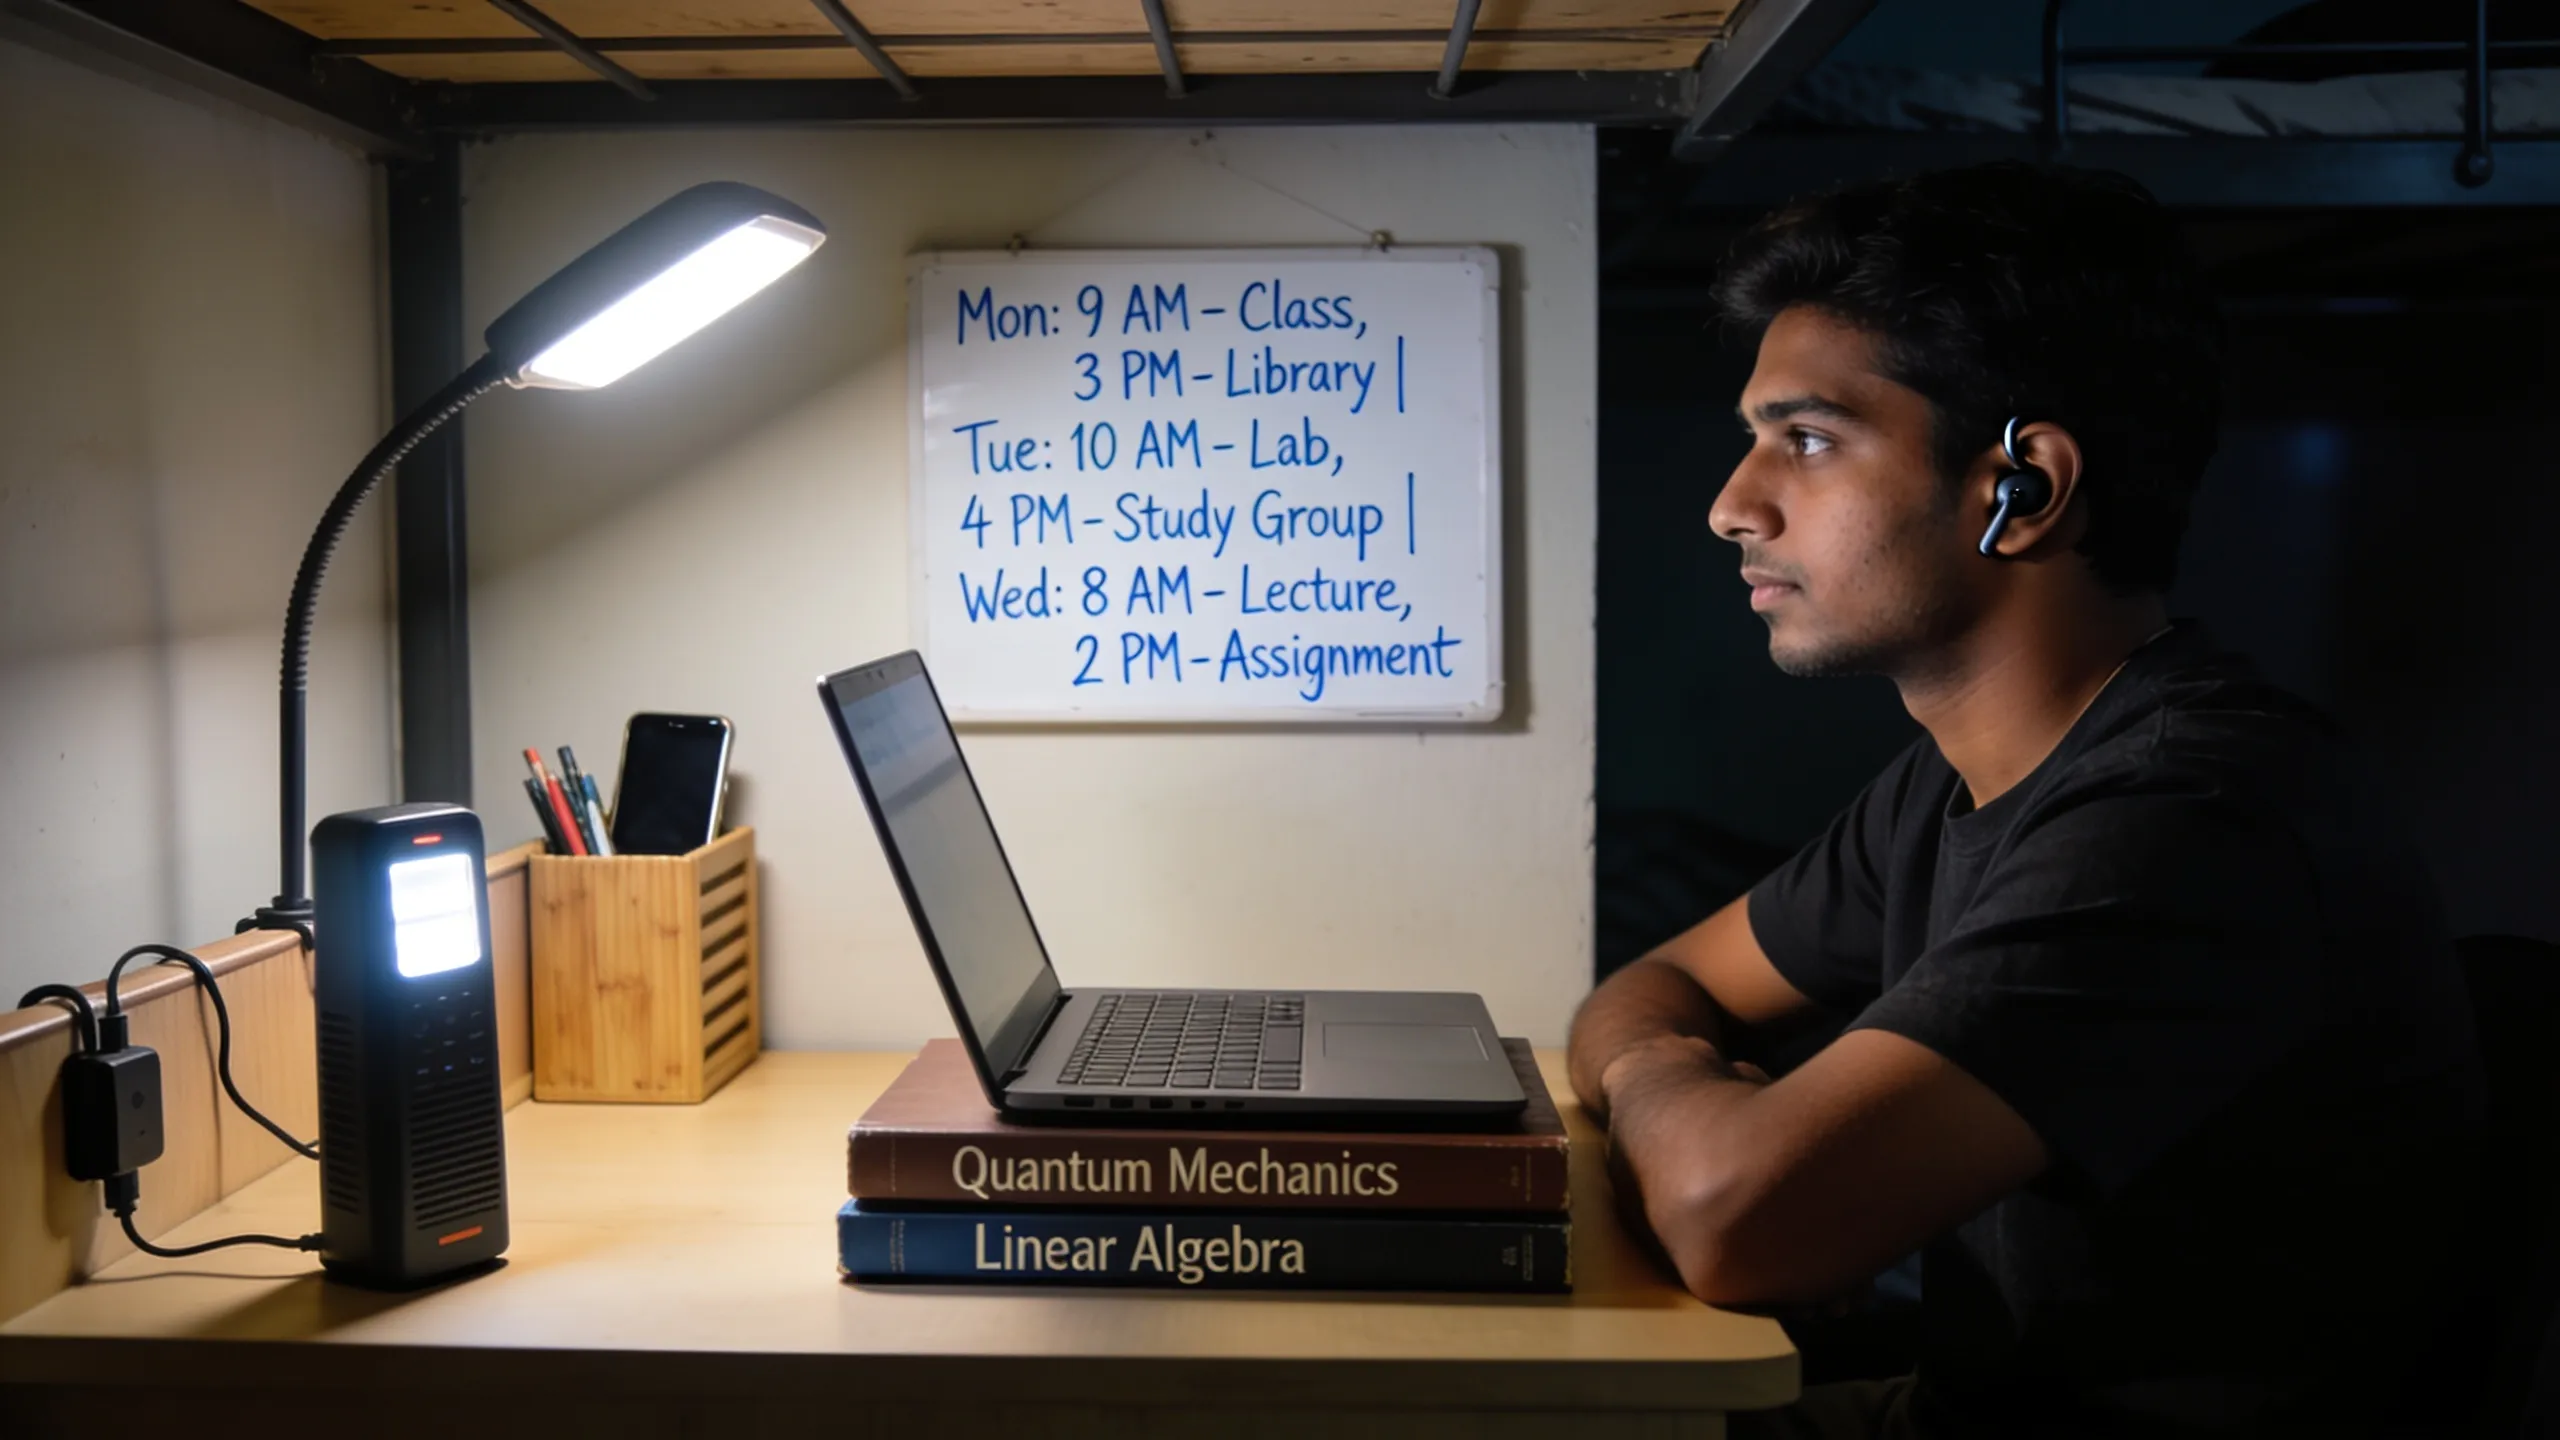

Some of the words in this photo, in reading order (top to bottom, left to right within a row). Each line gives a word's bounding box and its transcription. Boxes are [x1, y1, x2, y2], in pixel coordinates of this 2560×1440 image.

[957, 287, 1060, 345] Mon:
[1075, 284, 1104, 337] 9
[1122, 284, 1191, 334] AM
[1238, 278, 1368, 339] Class,
[1073, 352, 1102, 401] 3
[1121, 349, 1184, 400] PM
[1225, 345, 1377, 415] Library
[952, 419, 1053, 476] Tue:
[1069, 420, 1118, 472] 10
[1134, 417, 1203, 471] AM
[1249, 415, 1345, 477] Lab,
[959, 494, 993, 549] 4
[1011, 493, 1075, 547] PM
[1113, 487, 1237, 559] Study
[1250, 488, 1385, 562] Group
[958, 566, 1063, 624] Wed:
[1081, 564, 1110, 617] 8
[1126, 564, 1194, 616] AM
[1240, 562, 1414, 623] Lecture,
[1071, 633, 1104, 688] 2
[1119, 630, 1183, 686] PM
[1217, 624, 1463, 704] Assignment
[951, 1144, 1153, 1202] Quantum
[1168, 1146, 1400, 1197] Mechanics
[973, 1221, 1118, 1274] Linear
[1128, 1223, 1306, 1286] Algebra
